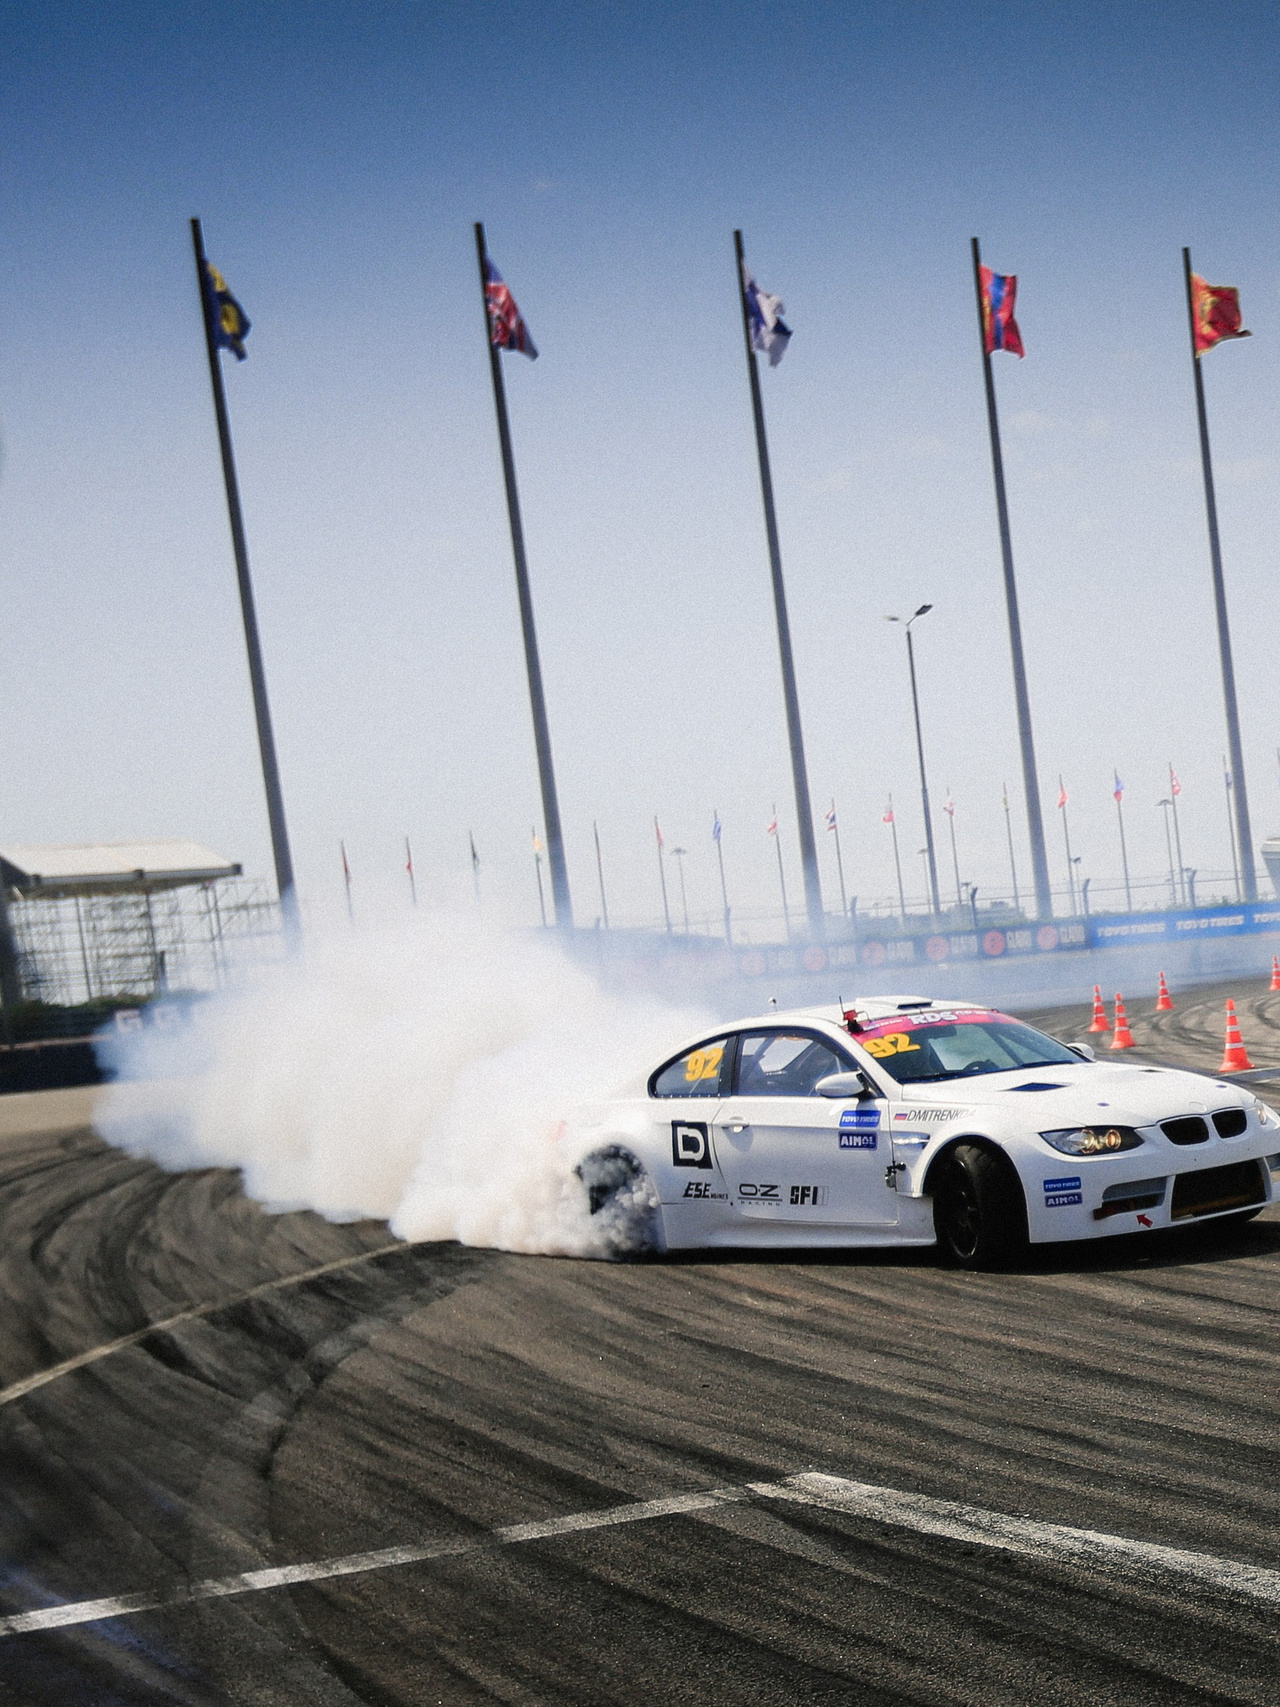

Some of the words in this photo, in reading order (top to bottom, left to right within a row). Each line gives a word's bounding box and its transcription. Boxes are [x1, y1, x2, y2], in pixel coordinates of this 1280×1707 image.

[907, 1011, 959, 1025] RDS
[862, 1033, 921, 1059] 92
[684, 1047, 724, 1083] 92
